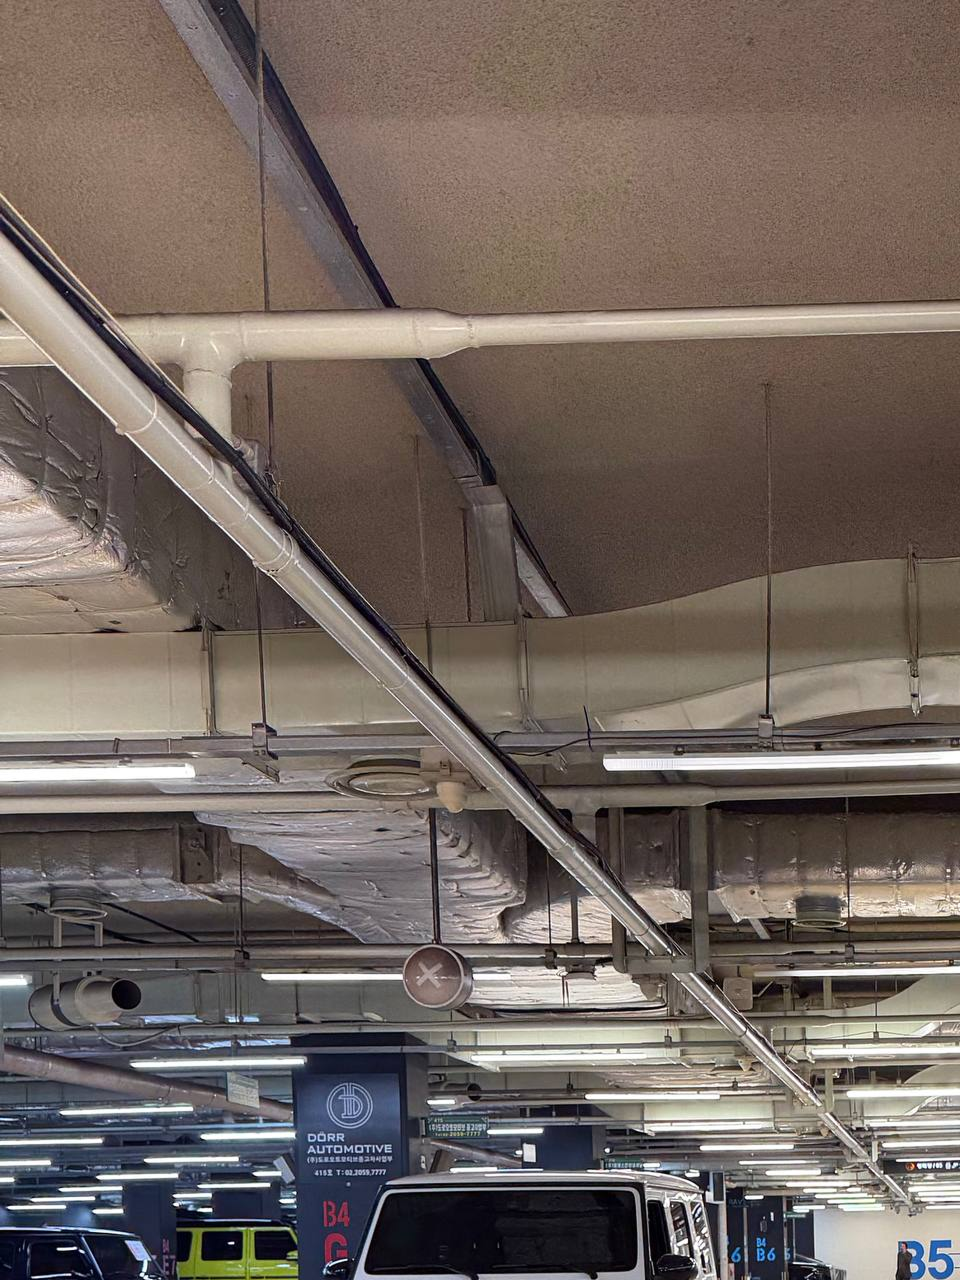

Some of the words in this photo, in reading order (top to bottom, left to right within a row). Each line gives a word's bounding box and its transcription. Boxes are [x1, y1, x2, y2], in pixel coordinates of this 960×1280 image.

[307, 1131, 345, 1142] DÖRR
[307, 1144, 393, 1154] AUTOMOTIVE
[322, 1200, 350, 1227] B4
[756, 1247, 776, 1262] B6
